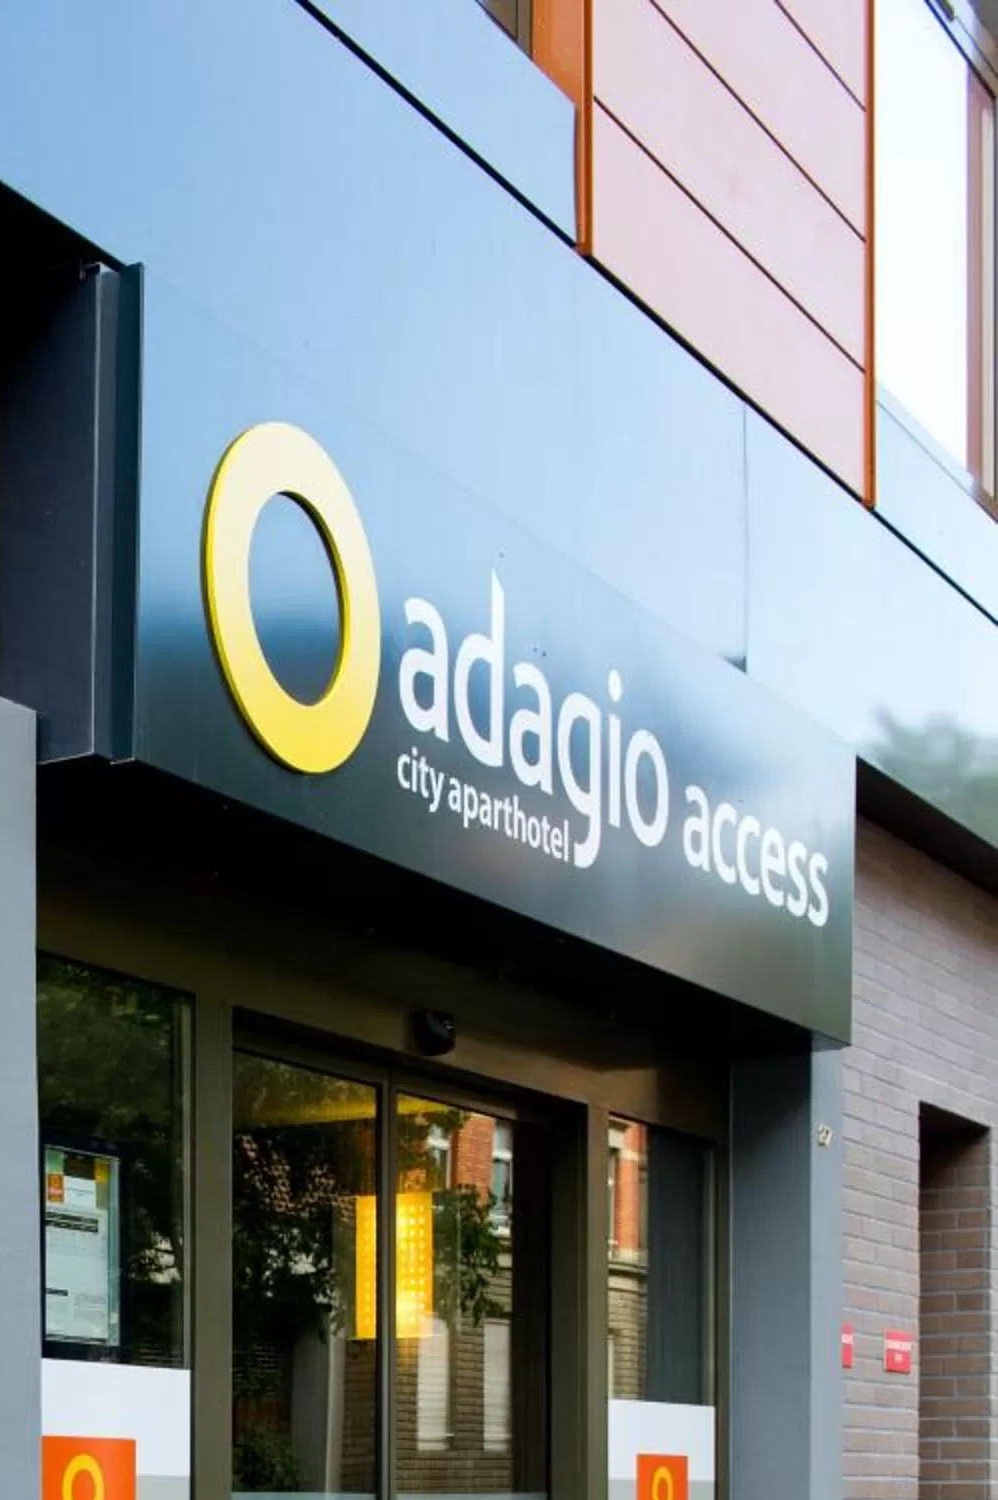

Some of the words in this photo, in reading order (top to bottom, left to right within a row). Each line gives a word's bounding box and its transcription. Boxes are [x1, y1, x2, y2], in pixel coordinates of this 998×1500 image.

[396, 744, 445, 813] city
[448, 776, 570, 863] aparthotel
[398, 568, 669, 869] adagio
[683, 783, 829, 928] access
